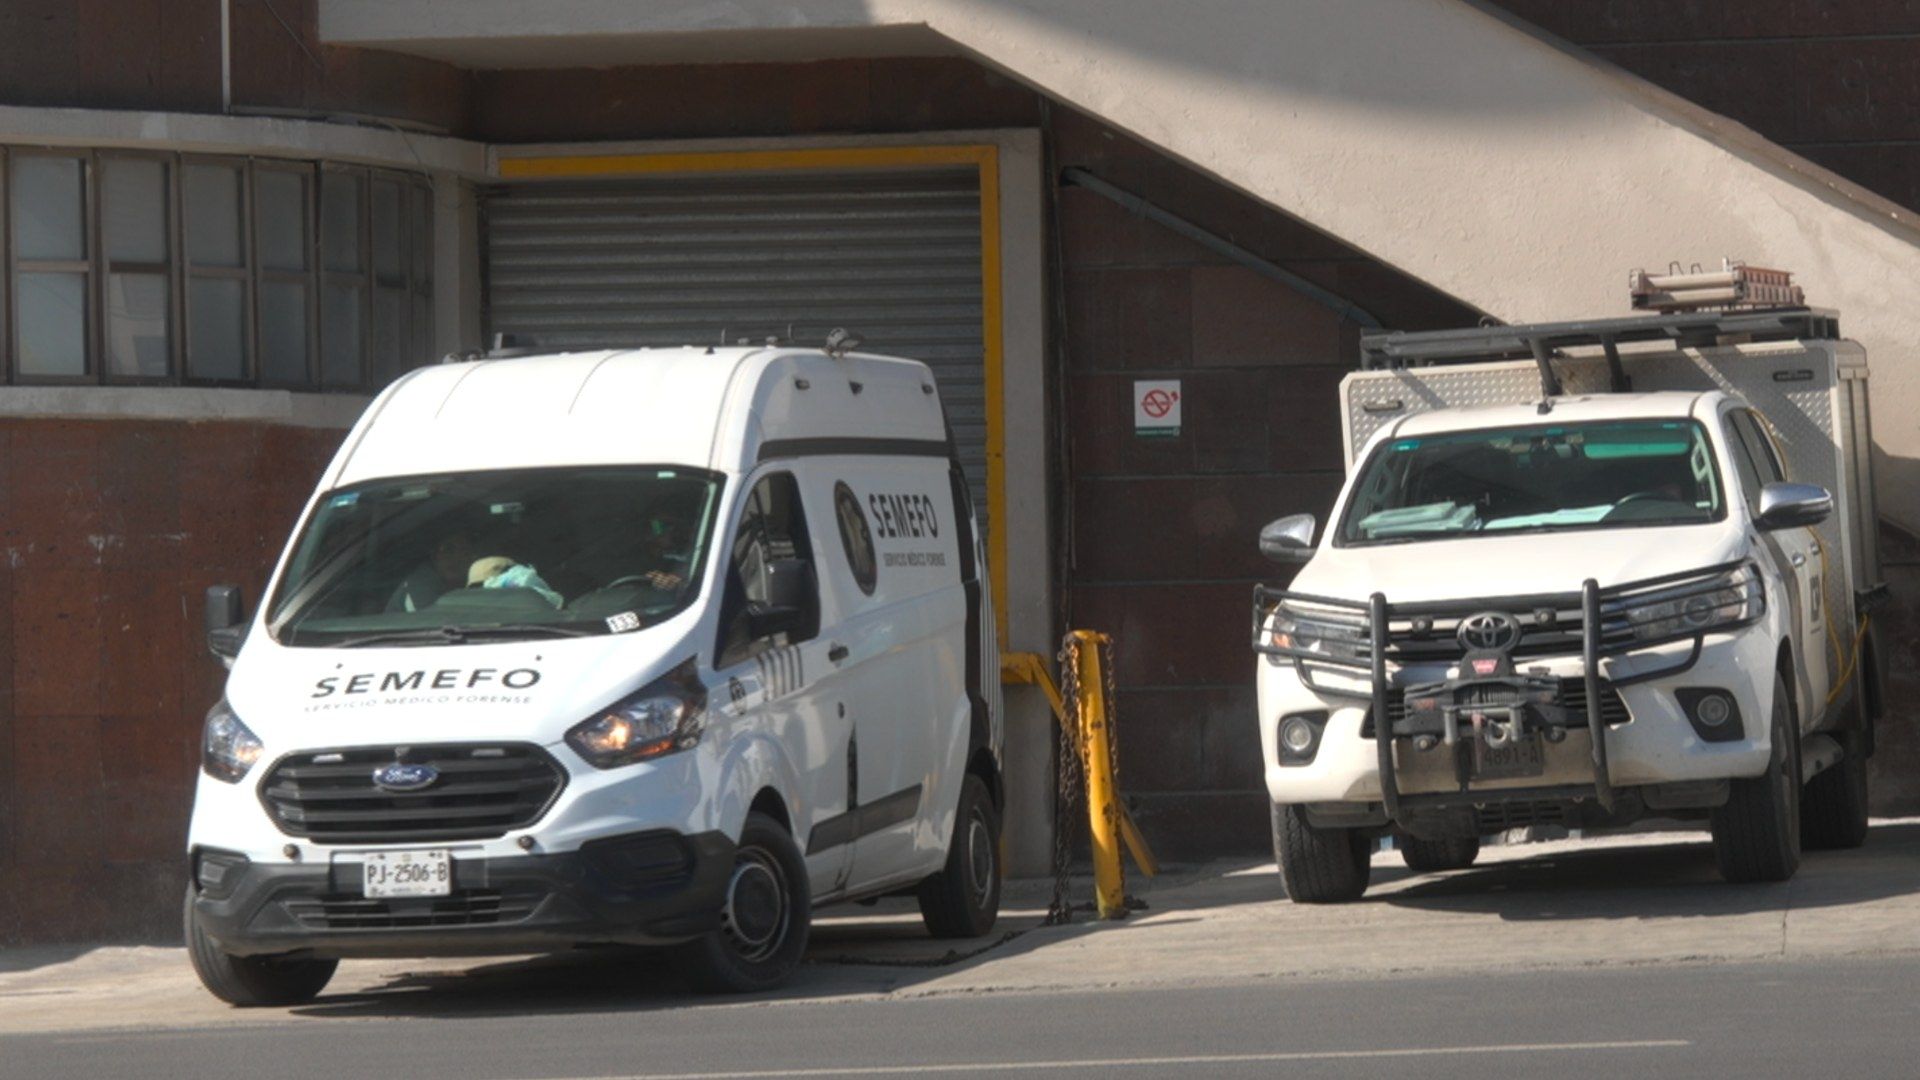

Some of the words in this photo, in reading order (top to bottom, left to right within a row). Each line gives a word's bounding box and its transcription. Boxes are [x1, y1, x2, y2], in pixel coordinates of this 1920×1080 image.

[869, 493, 938, 538] SEMEFO
[926, 552, 946, 567] FORENSE
[311, 668, 541, 698] SEMEFO
[304, 699, 377, 713] SERVICIO
[456, 695, 532, 704] FORENSE
[385, 767, 421, 783] Ford
[367, 862, 448, 885] PJ-2506-B
